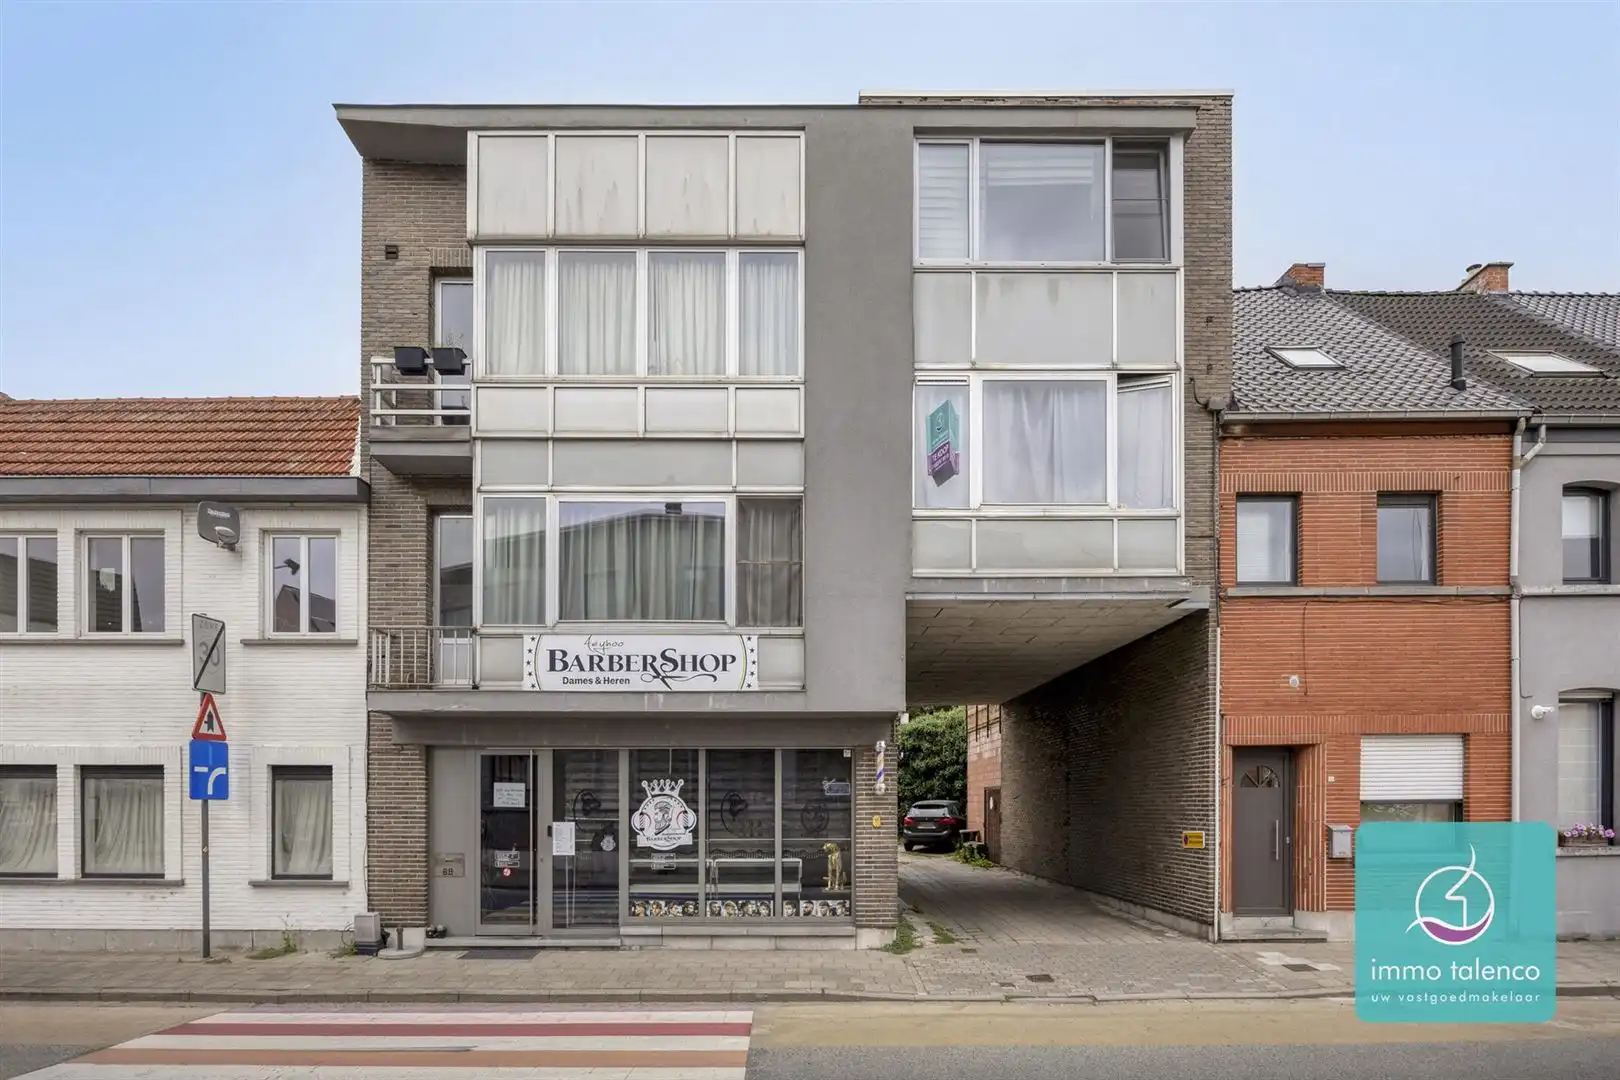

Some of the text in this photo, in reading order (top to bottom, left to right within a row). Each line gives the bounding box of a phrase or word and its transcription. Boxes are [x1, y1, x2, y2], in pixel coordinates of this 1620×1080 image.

[199, 641, 220, 667] 30
[562, 676, 630, 685] Dames & Heren
